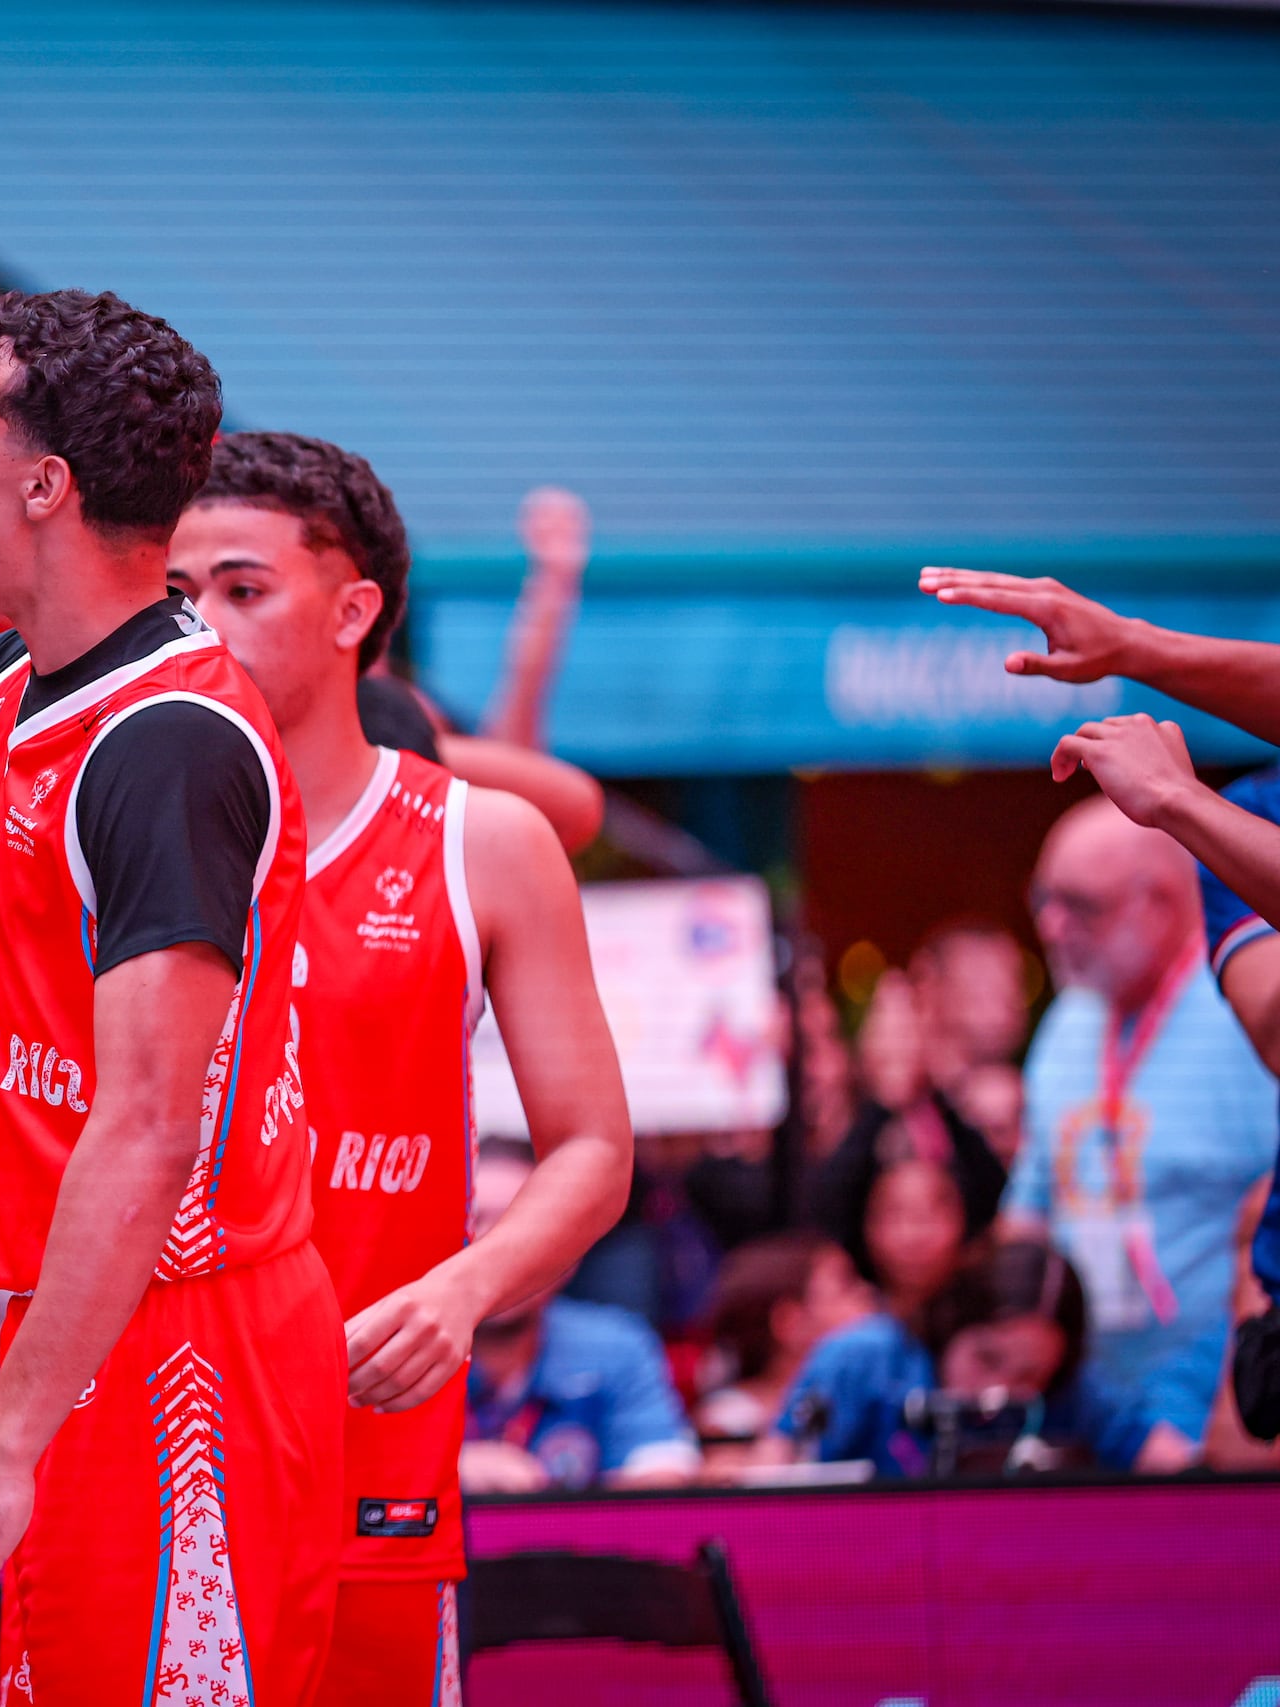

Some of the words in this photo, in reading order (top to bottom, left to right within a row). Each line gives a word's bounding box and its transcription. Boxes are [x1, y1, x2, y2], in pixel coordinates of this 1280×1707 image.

[8, 805, 38, 831] Special
[5, 818, 35, 847] lympics
[7, 839, 23, 851] erto
[330, 1131, 431, 1194] RICO
